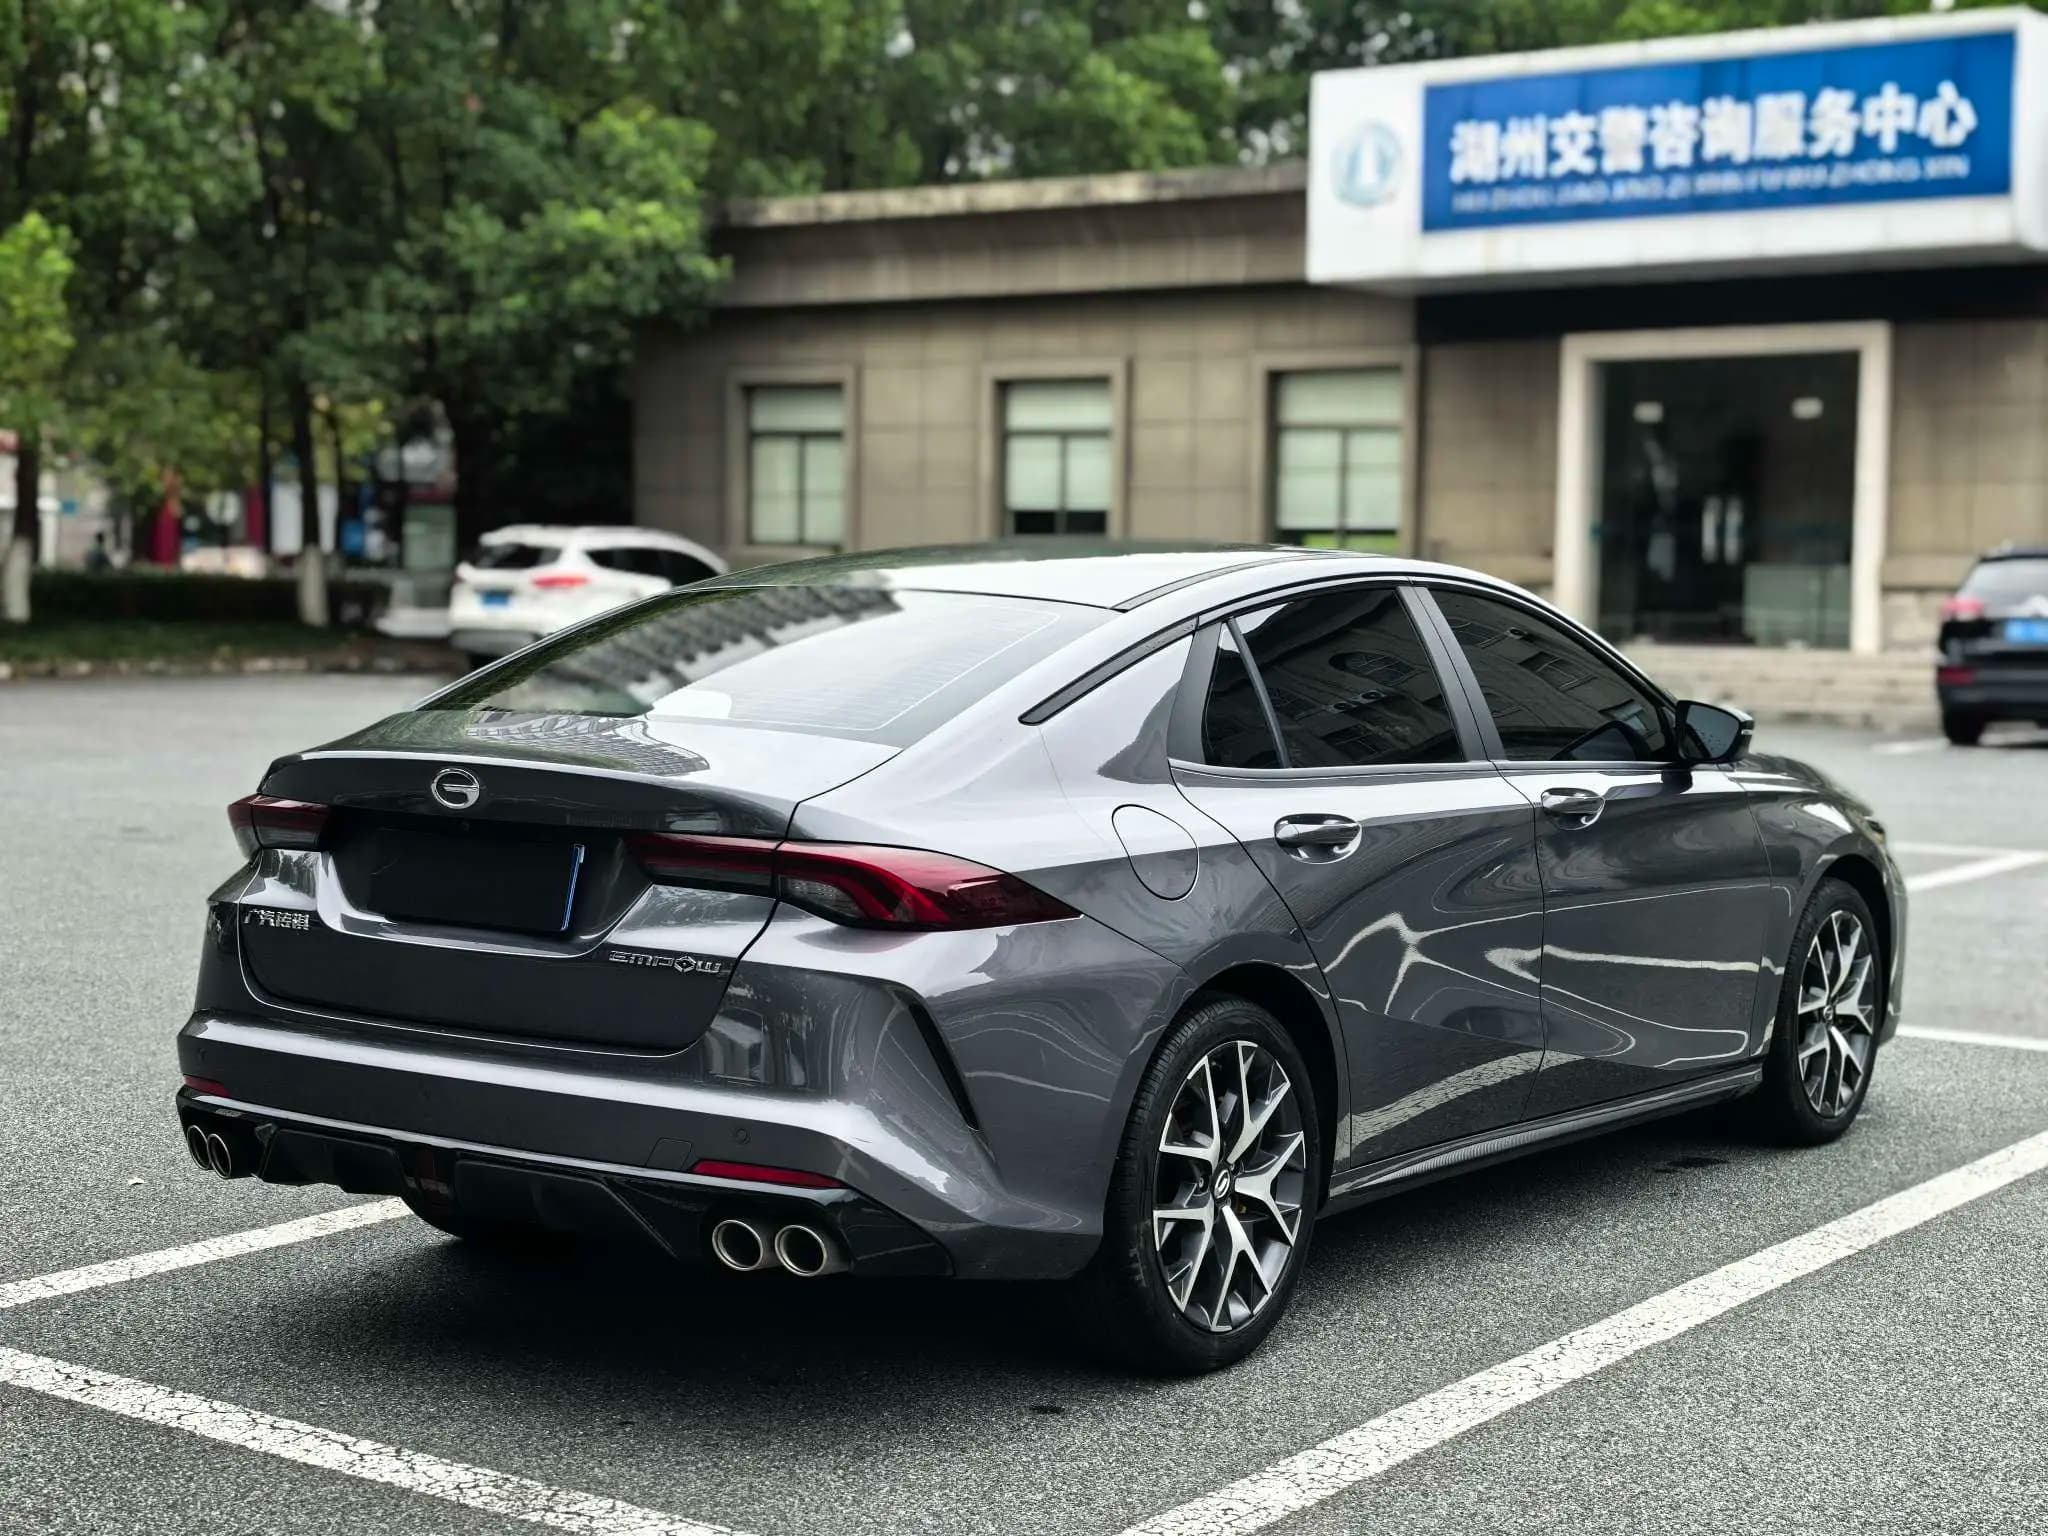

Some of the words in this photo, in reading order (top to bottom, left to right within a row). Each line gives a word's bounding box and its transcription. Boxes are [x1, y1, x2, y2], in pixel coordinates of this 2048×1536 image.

[1450, 80, 1977, 183] 湖州交警咨询服务中心
